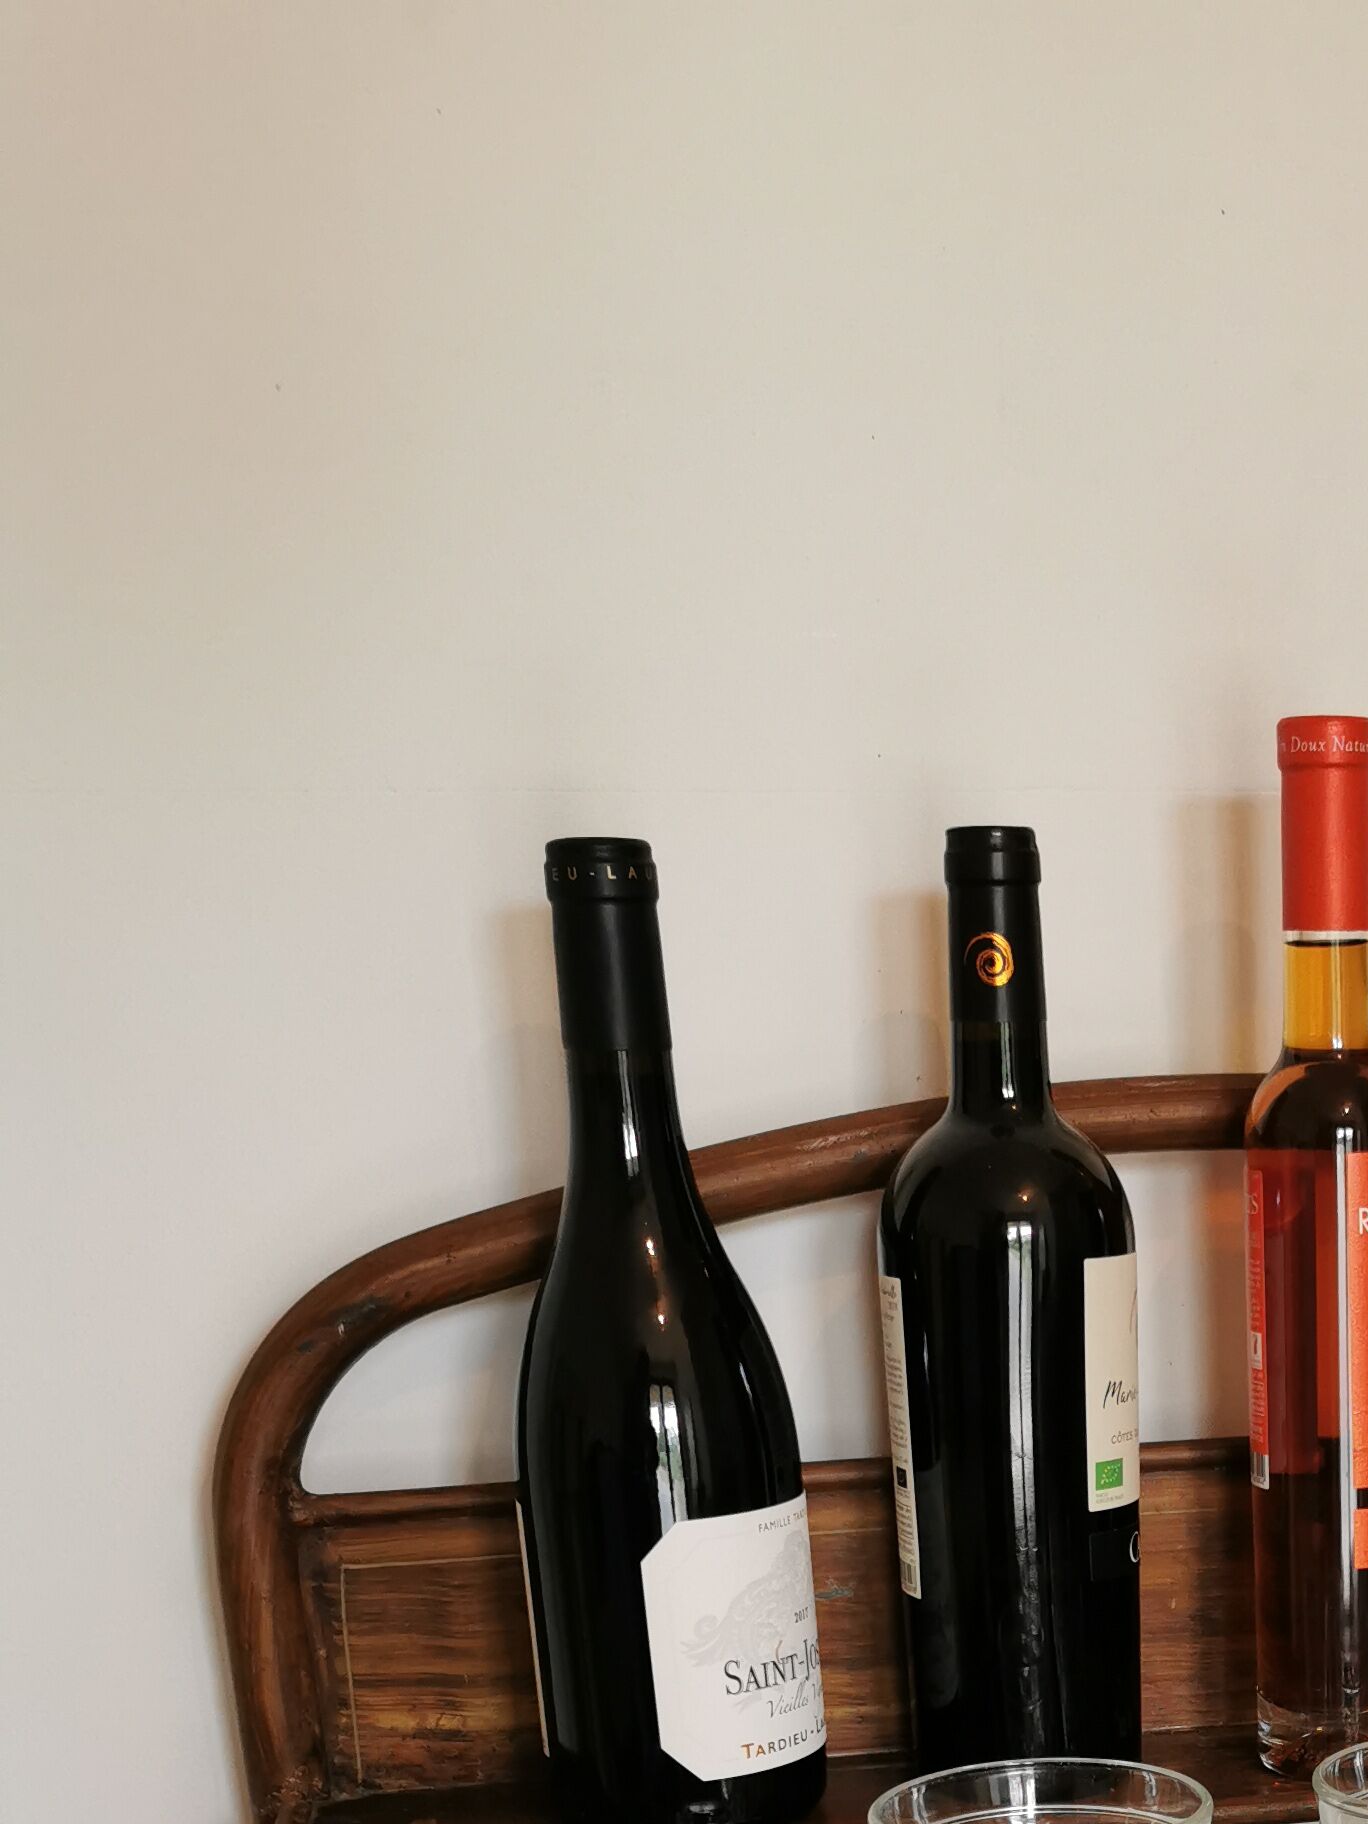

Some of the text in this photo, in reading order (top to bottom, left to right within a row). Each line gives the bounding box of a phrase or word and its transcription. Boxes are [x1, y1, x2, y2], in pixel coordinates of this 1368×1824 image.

[1290, 736, 1326, 752] Doux
[1110, 1430, 1133, 1445] CÔTES
[758, 1515, 791, 1533] FAMILLE
